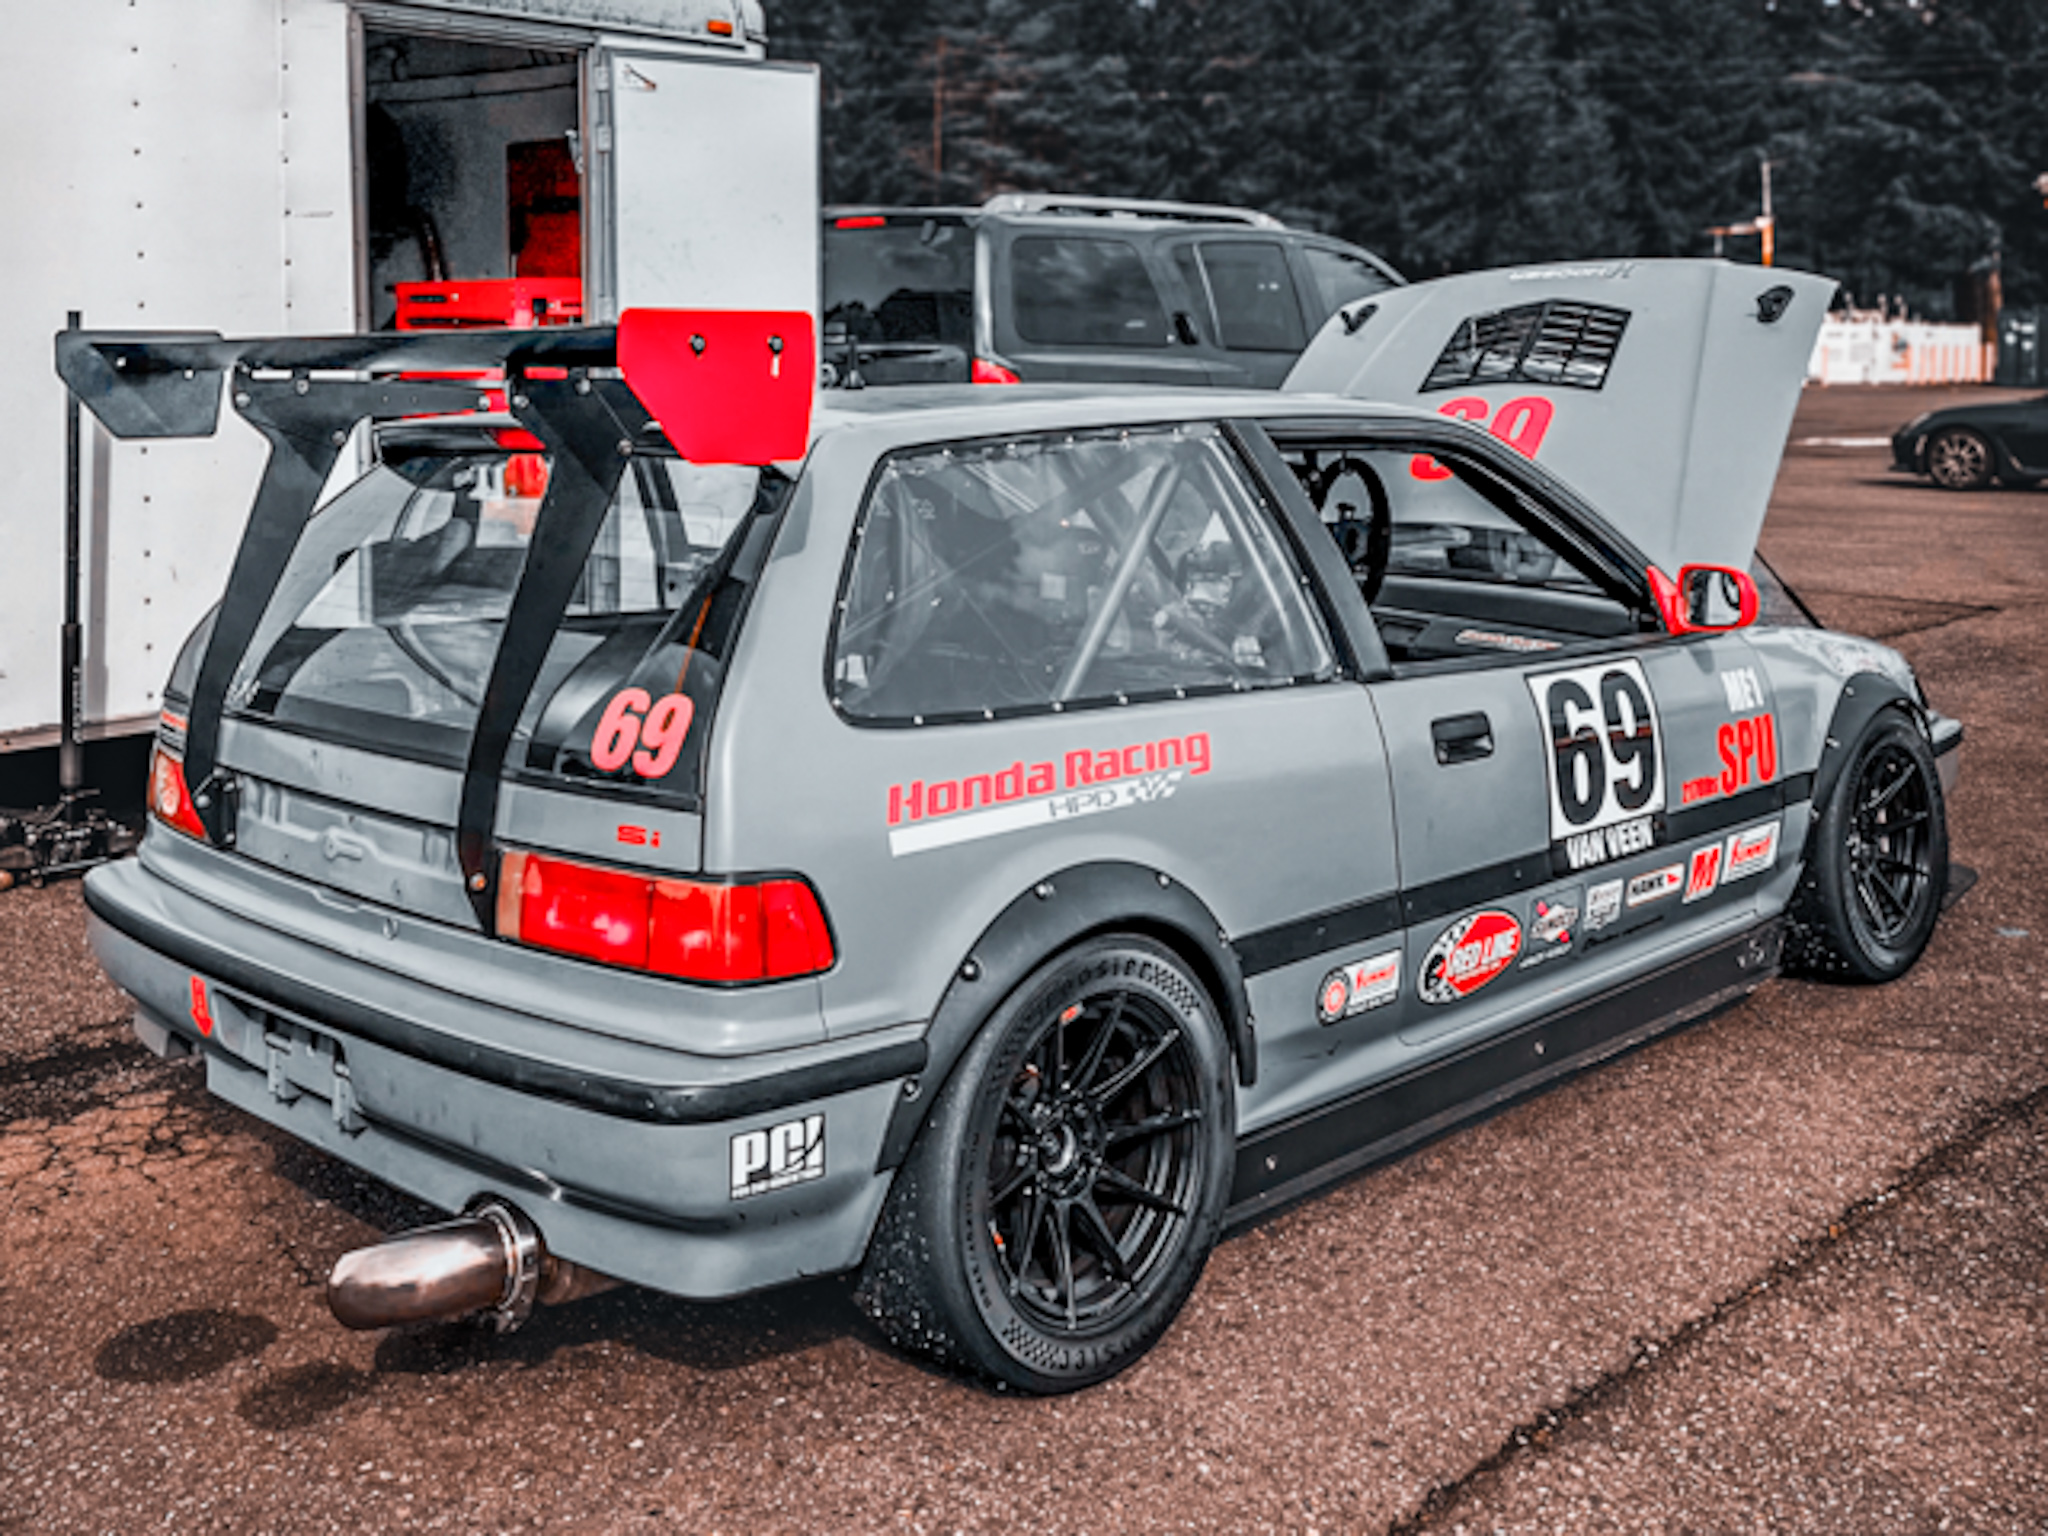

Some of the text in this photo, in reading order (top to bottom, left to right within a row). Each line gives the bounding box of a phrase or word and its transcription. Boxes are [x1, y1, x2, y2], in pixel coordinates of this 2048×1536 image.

[590, 686, 696, 779] 69
[1547, 669, 1656, 825] 69
[1718, 712, 1776, 797] SPU
[887, 732, 1212, 826] Honda Racing
[1049, 788, 1118, 818] HPD
[616, 822, 661, 848] Si
[1565, 814, 1655, 869] VAN VEEN
[1447, 939, 1483, 978] RED
[1480, 926, 1520, 966] LINE
